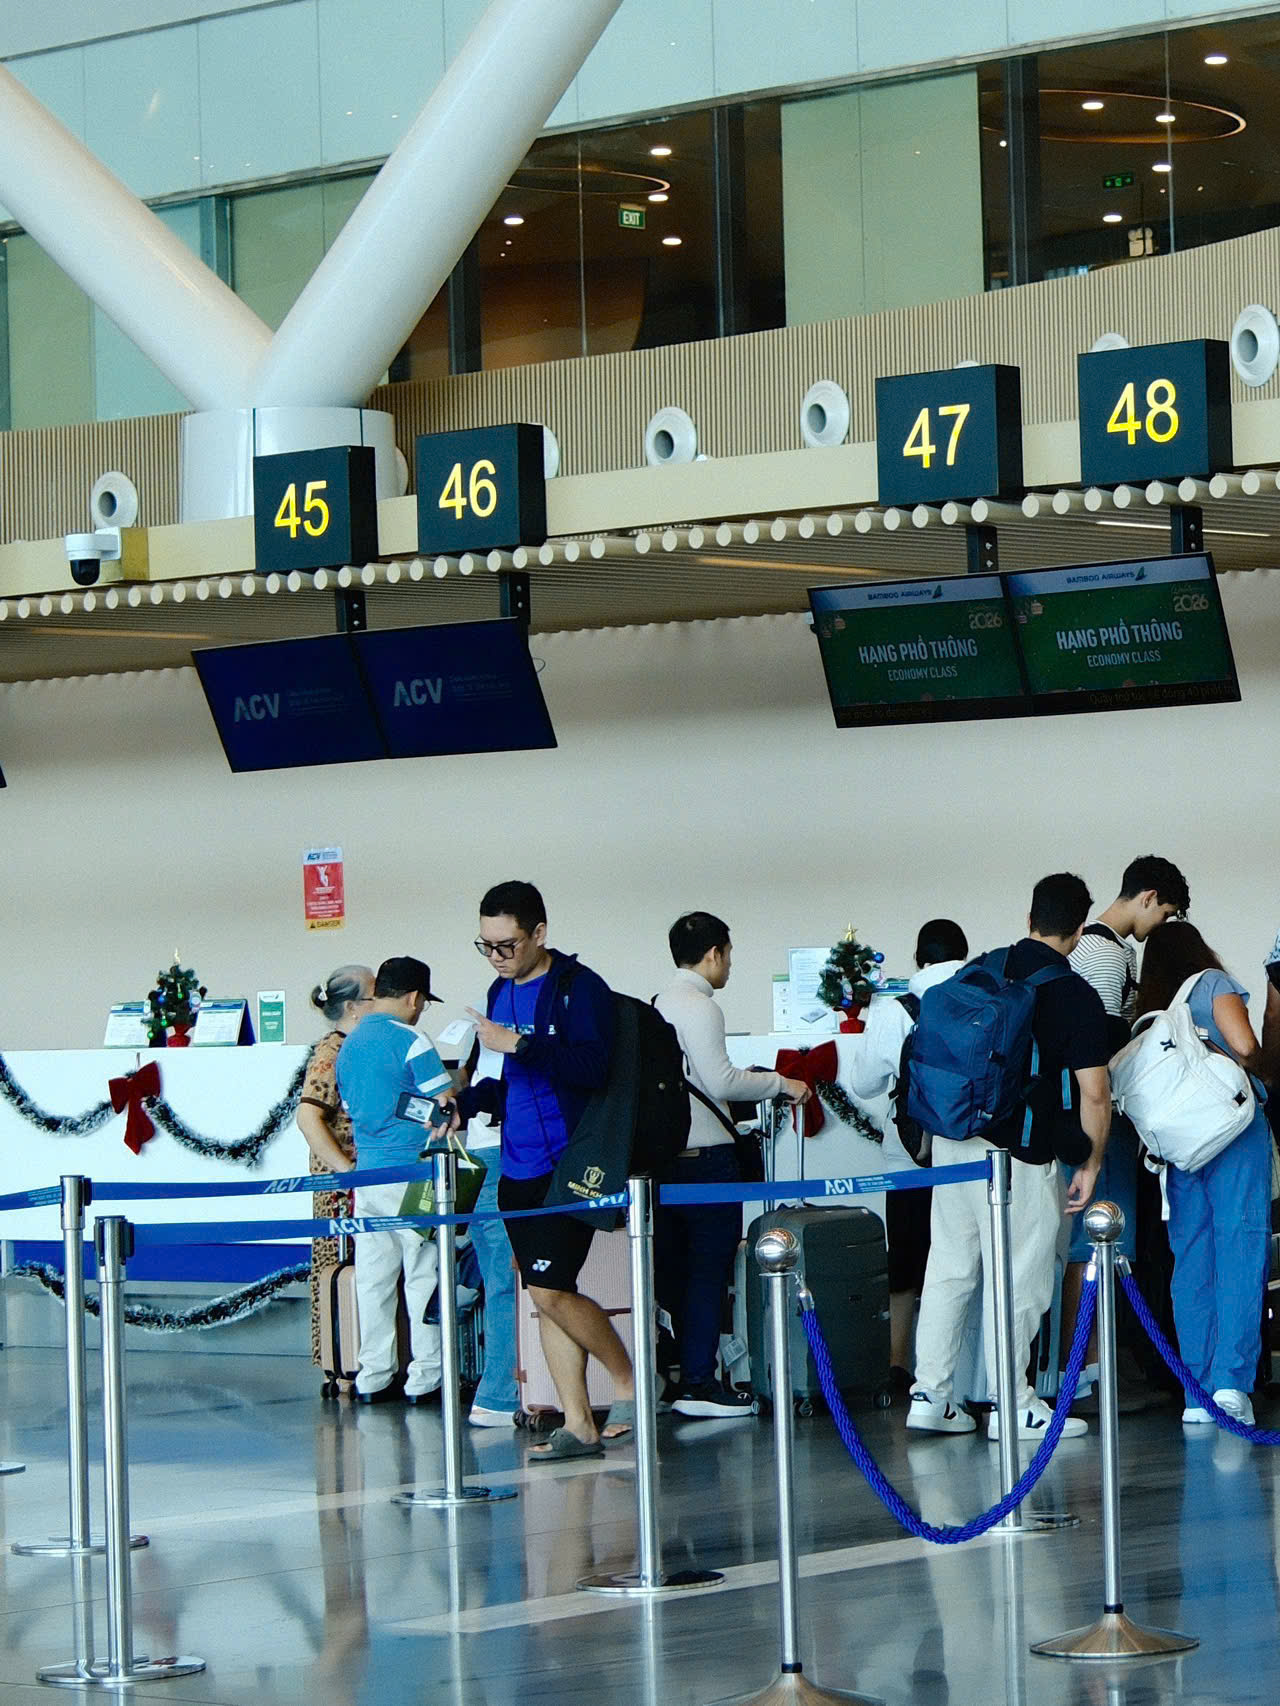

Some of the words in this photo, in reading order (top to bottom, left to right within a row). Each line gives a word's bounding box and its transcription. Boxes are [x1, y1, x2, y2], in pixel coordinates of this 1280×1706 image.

[624, 211, 640, 225] EXIT
[1106, 378, 1180, 446] 48
[902, 403, 971, 469] 47
[439, 459, 497, 519] 46
[274, 480, 330, 539] 45
[1173, 593, 1209, 612] 2026
[1056, 630, 1097, 654] HẠNG
[1099, 618, 1130, 646] PHỔ
[1131, 618, 1183, 642] THÔNG
[858, 645, 898, 668] HẠNG
[900, 635, 928, 661] PHỔ
[930, 635, 978, 659] THÔNG
[1087, 652, 1130, 668] ECONOMY
[1131, 649, 1161, 664] CLASS
[887, 666, 928, 682] ECONOMY
[930, 664, 959, 679] CLASS
[393, 677, 443, 707] ACV
[234, 693, 281, 723] ACV
[264, 1178, 302, 1193] ACV
[825, 1179, 854, 1195] ACV
[330, 1219, 366, 1234] ACV
